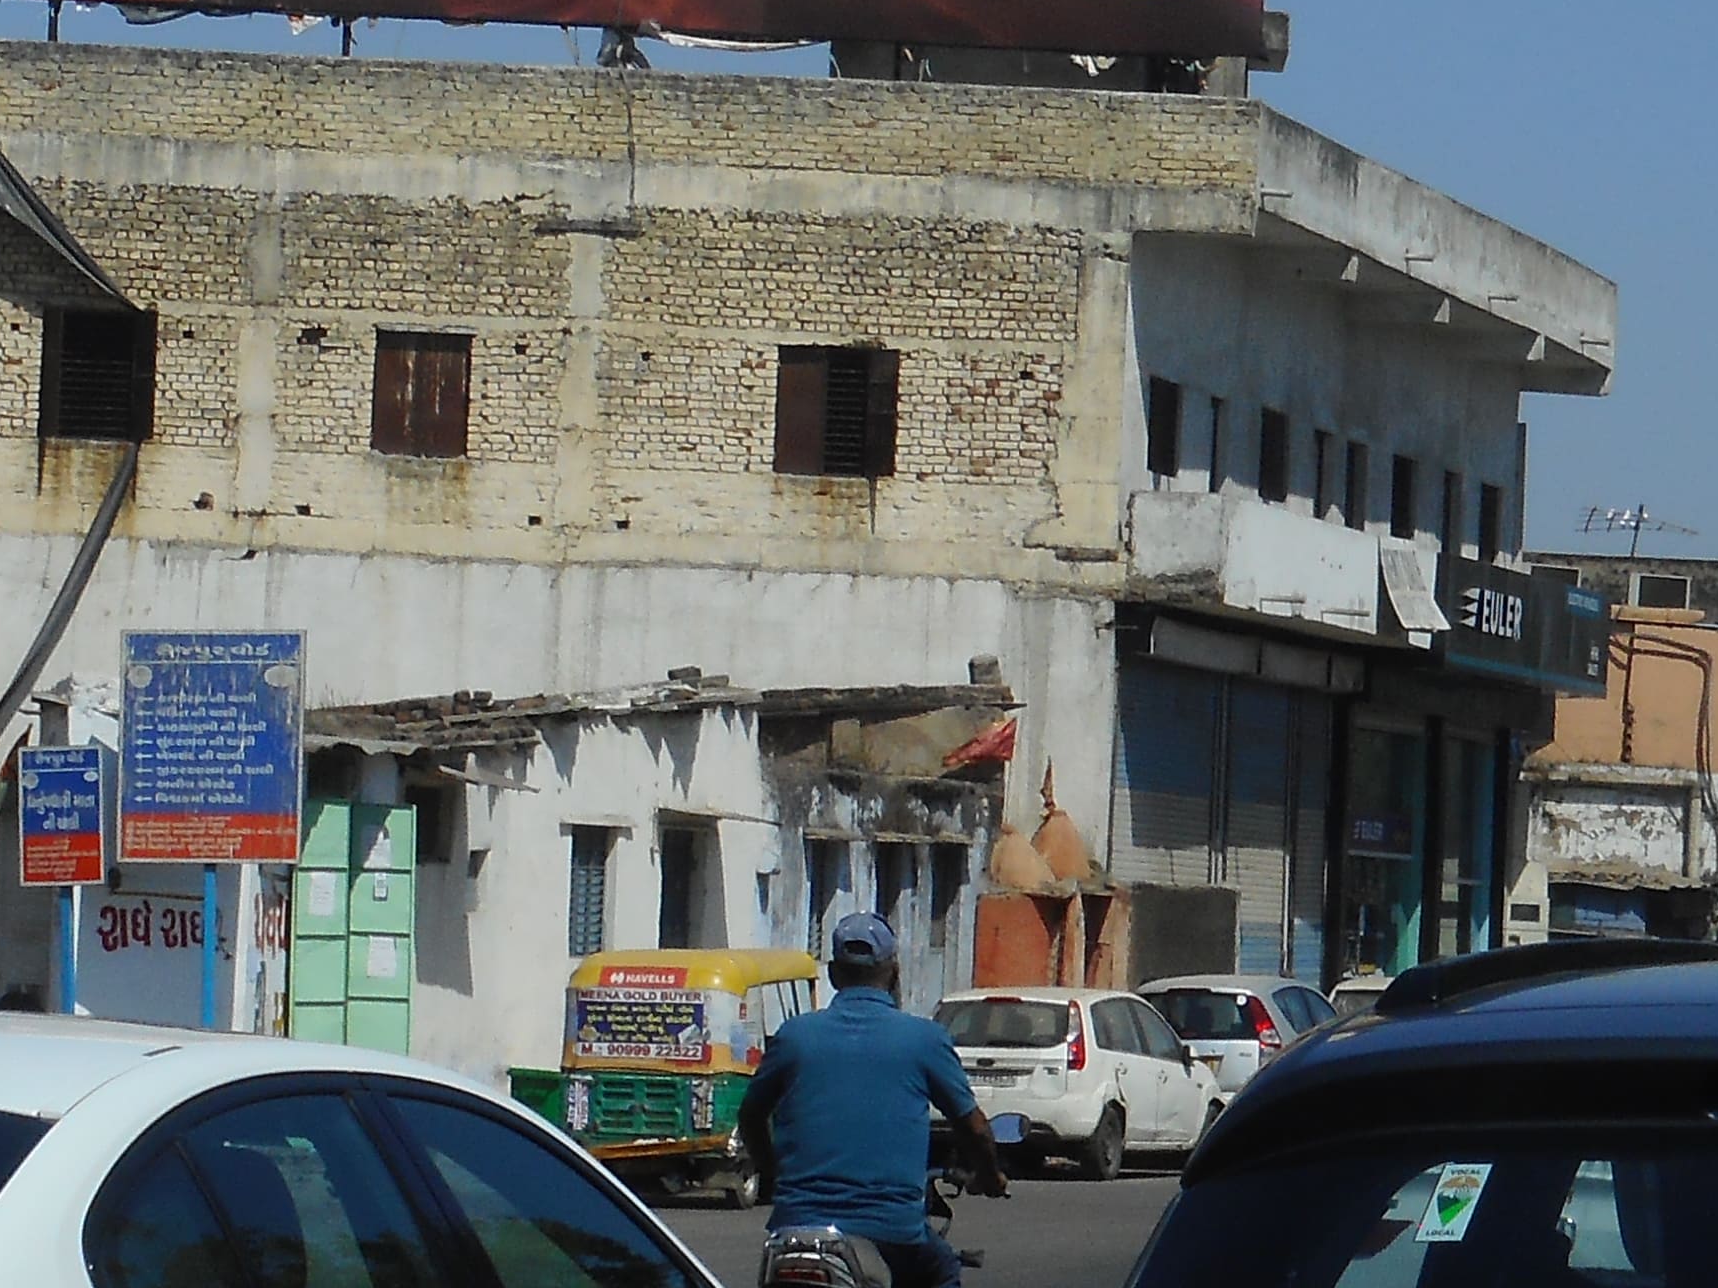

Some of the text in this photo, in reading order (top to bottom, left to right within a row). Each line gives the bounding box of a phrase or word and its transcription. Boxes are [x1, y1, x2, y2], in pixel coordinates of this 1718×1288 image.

[1482, 589, 1523, 641] EULER
[623, 991, 657, 1001] GOLD
[660, 992, 702, 1002] BUYER
[606, 1044, 651, 1056] 90999
[654, 1046, 700, 1058] 22522
[1424, 1229, 1455, 1237] LOCAL
